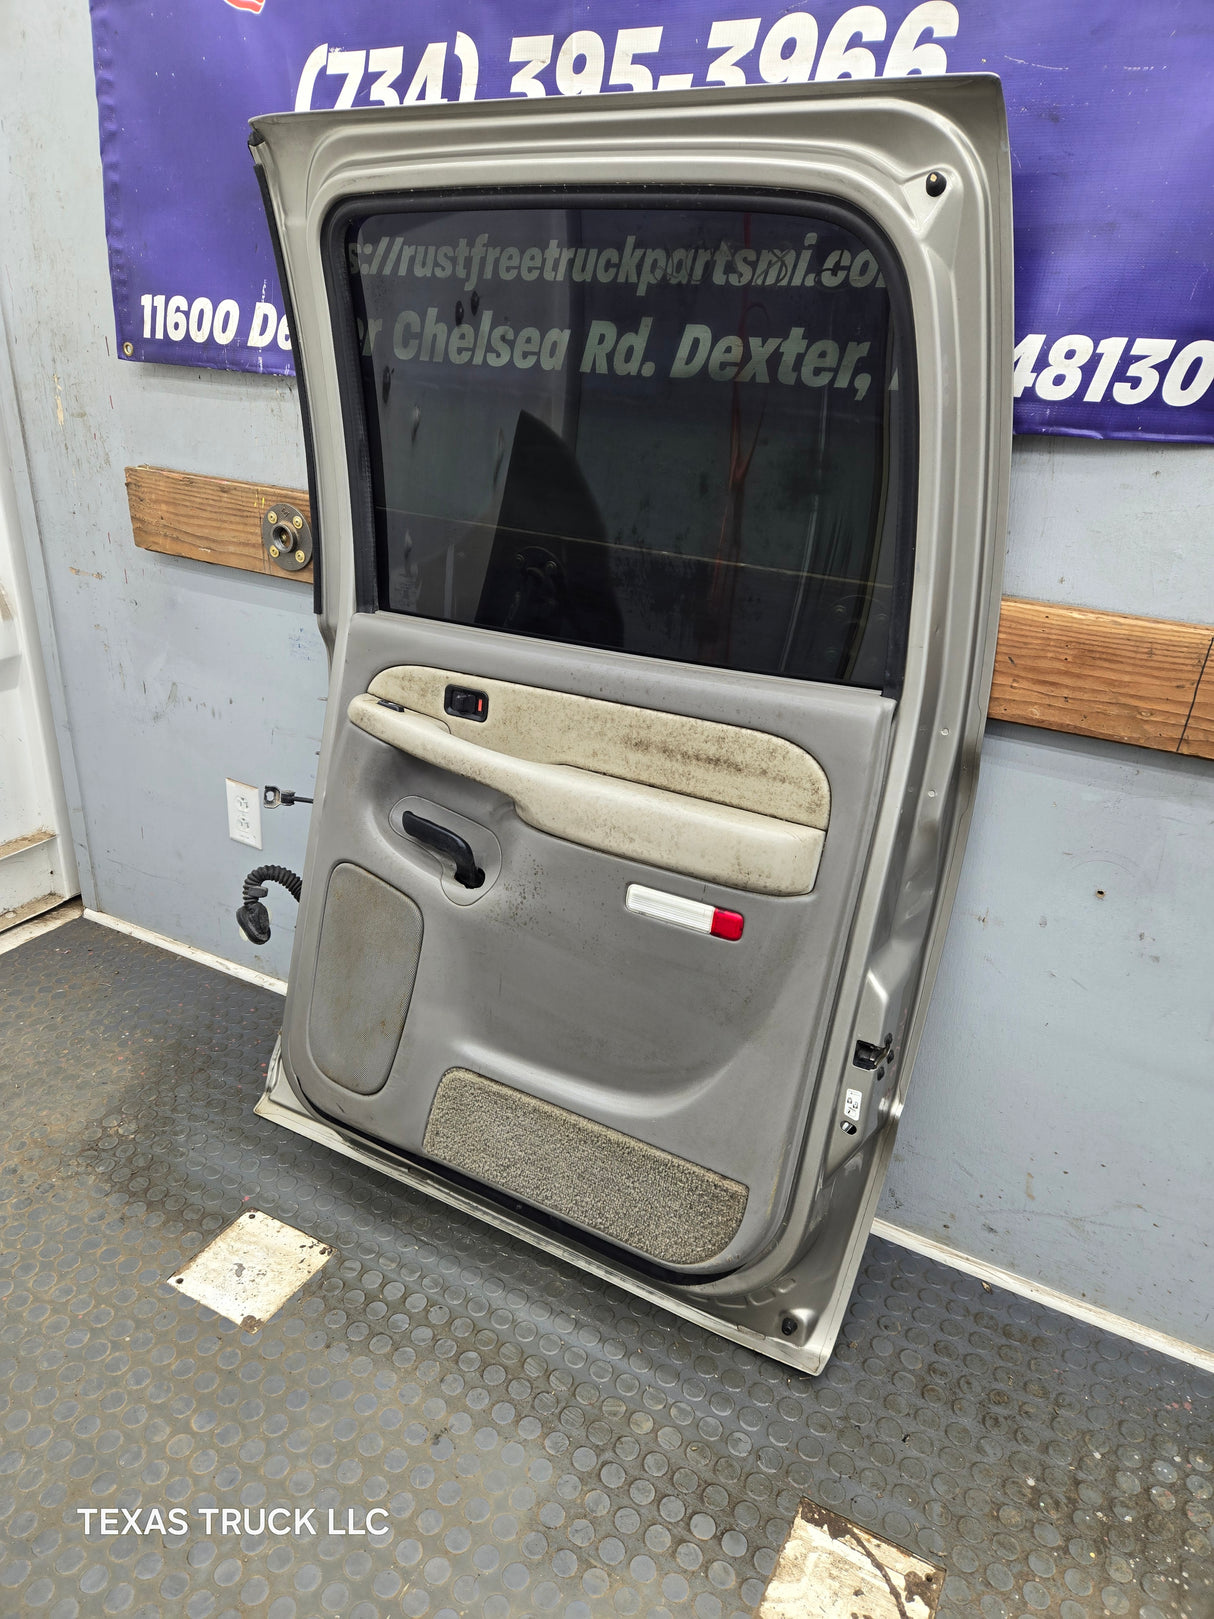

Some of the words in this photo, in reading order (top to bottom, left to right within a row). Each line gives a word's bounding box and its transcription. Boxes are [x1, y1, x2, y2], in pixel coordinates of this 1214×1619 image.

[294, 31, 479, 112] (734)
[508, 0, 960, 98] 395-3966
[349, 232, 887, 296] s://rustfreetruckpartsmi.co
[140, 294, 240, 345] 11600
[393, 307, 571, 371] Chelsea
[579, 317, 656, 377] Rd.
[669, 323, 872, 401] Dexter,
[1013, 334, 1214, 407] 48130
